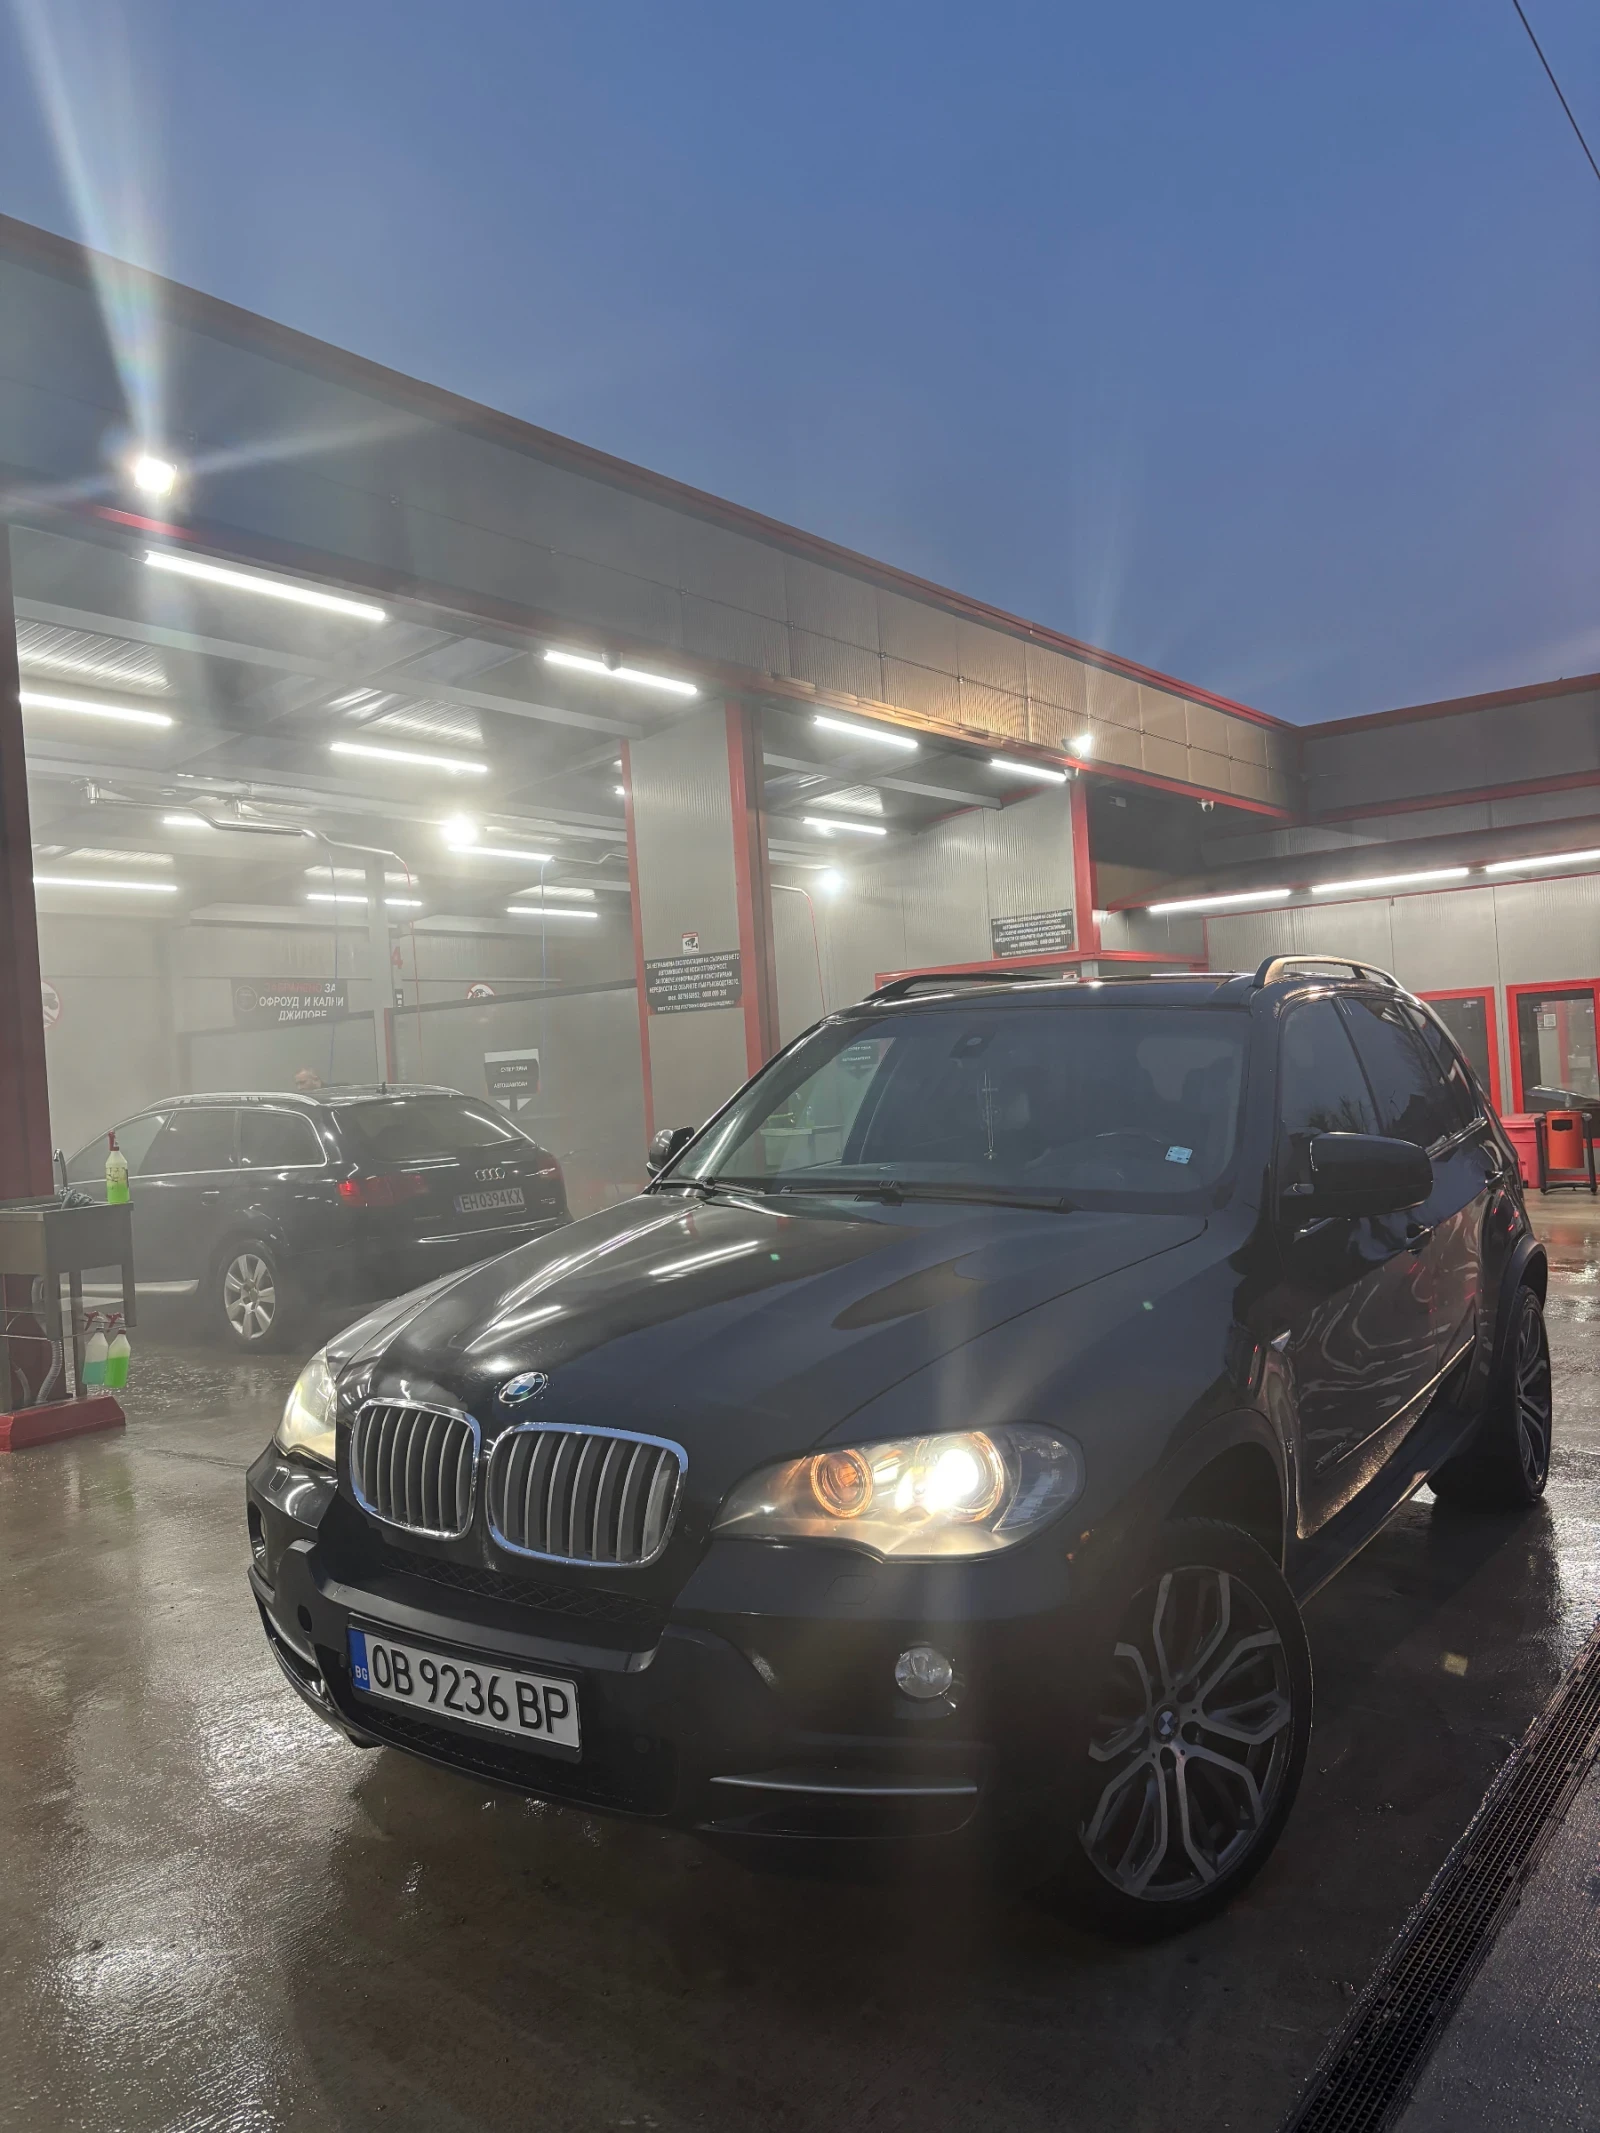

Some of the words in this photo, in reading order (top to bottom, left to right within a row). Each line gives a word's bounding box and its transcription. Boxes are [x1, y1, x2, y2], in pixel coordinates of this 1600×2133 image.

[324, 983, 336, 993] ЗА
[259, 996, 300, 1009] ОФРОУД
[304, 996, 311, 1007] И
[313, 996, 344, 1007] КАЛНИ
[355, 1665, 369, 1681] BG
